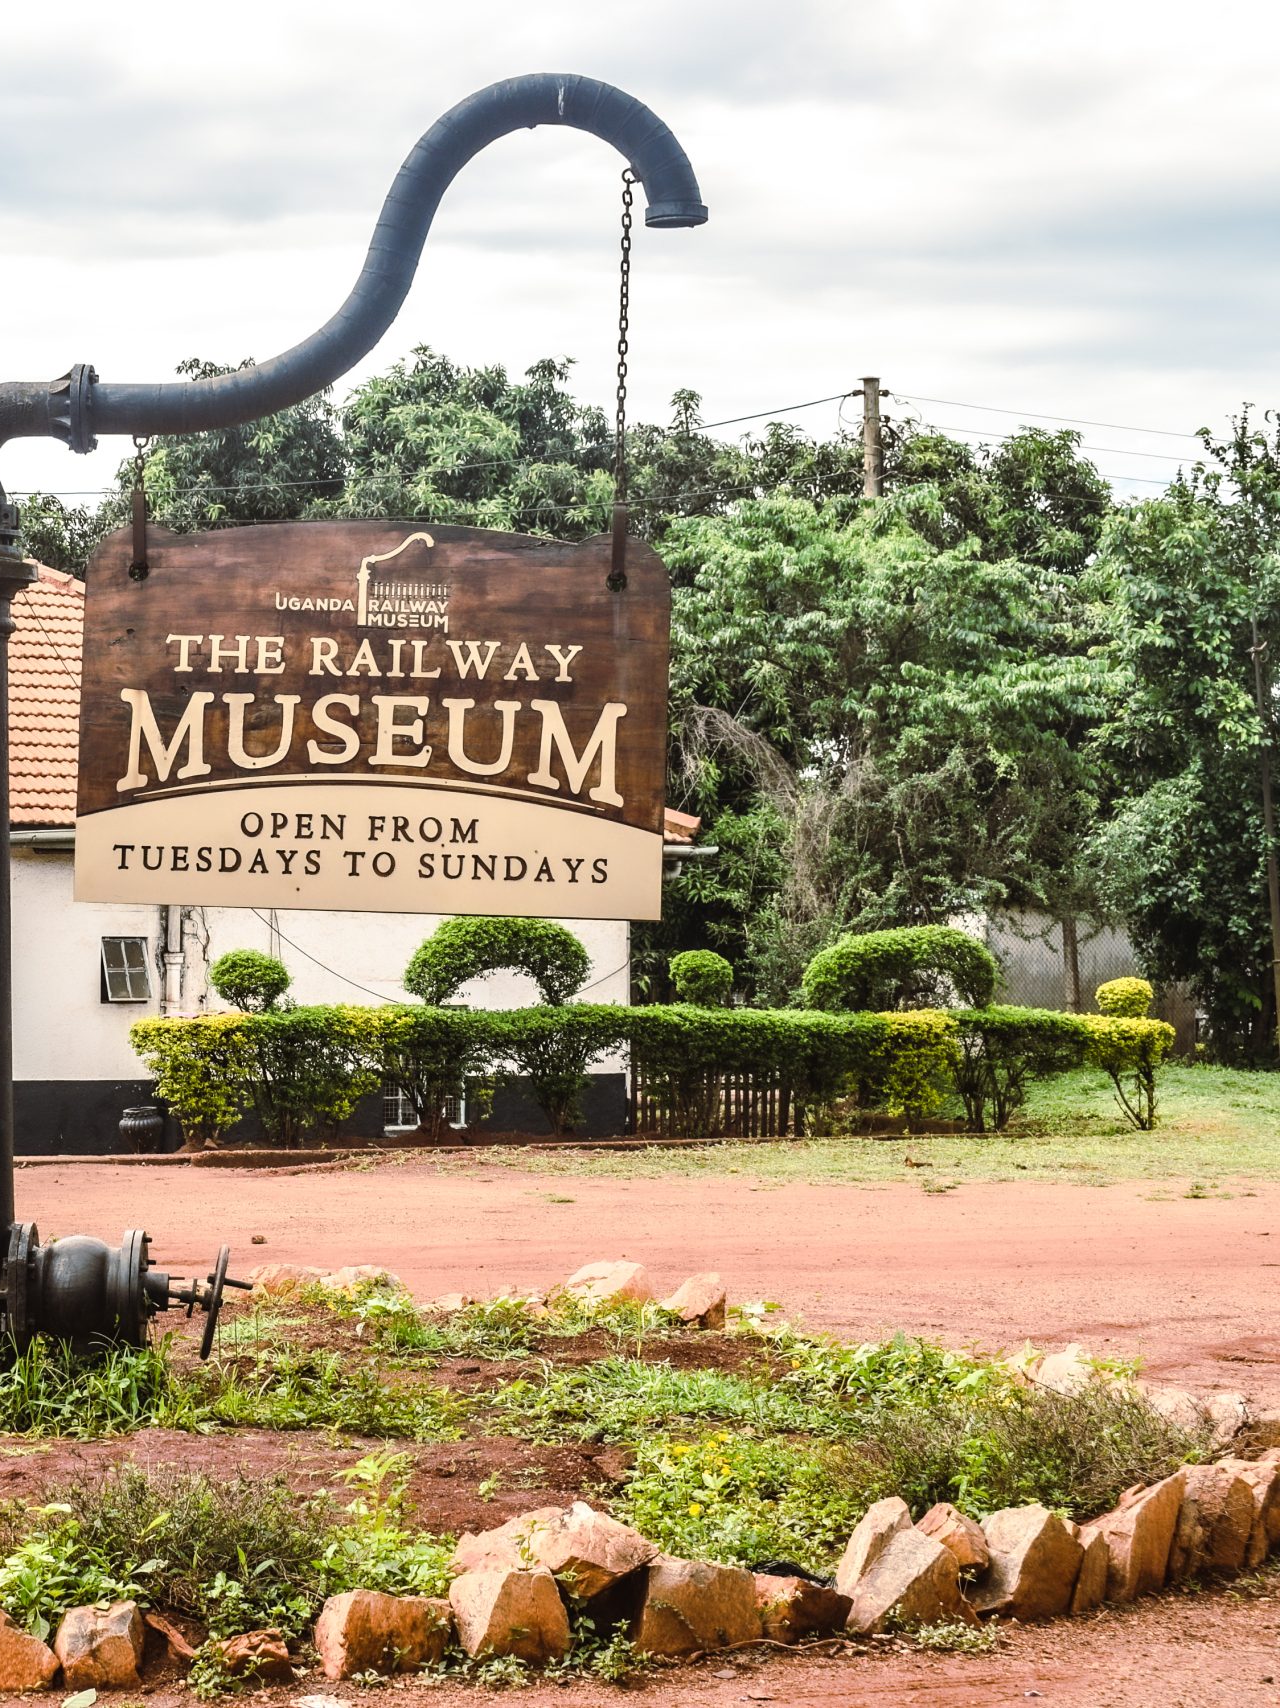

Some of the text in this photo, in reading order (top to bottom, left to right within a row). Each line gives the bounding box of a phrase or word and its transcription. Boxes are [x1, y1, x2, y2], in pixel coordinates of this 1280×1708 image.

[275, 591, 450, 614] UGANDA RAILWAY
[367, 613, 449, 634] MUSEUM
[165, 633, 584, 682] THE RAILWAY
[116, 687, 628, 808] MUSEUM
[240, 811, 480, 845] OPEN FROM
[112, 844, 609, 884] TUESDAYS TO SUNDAYS
